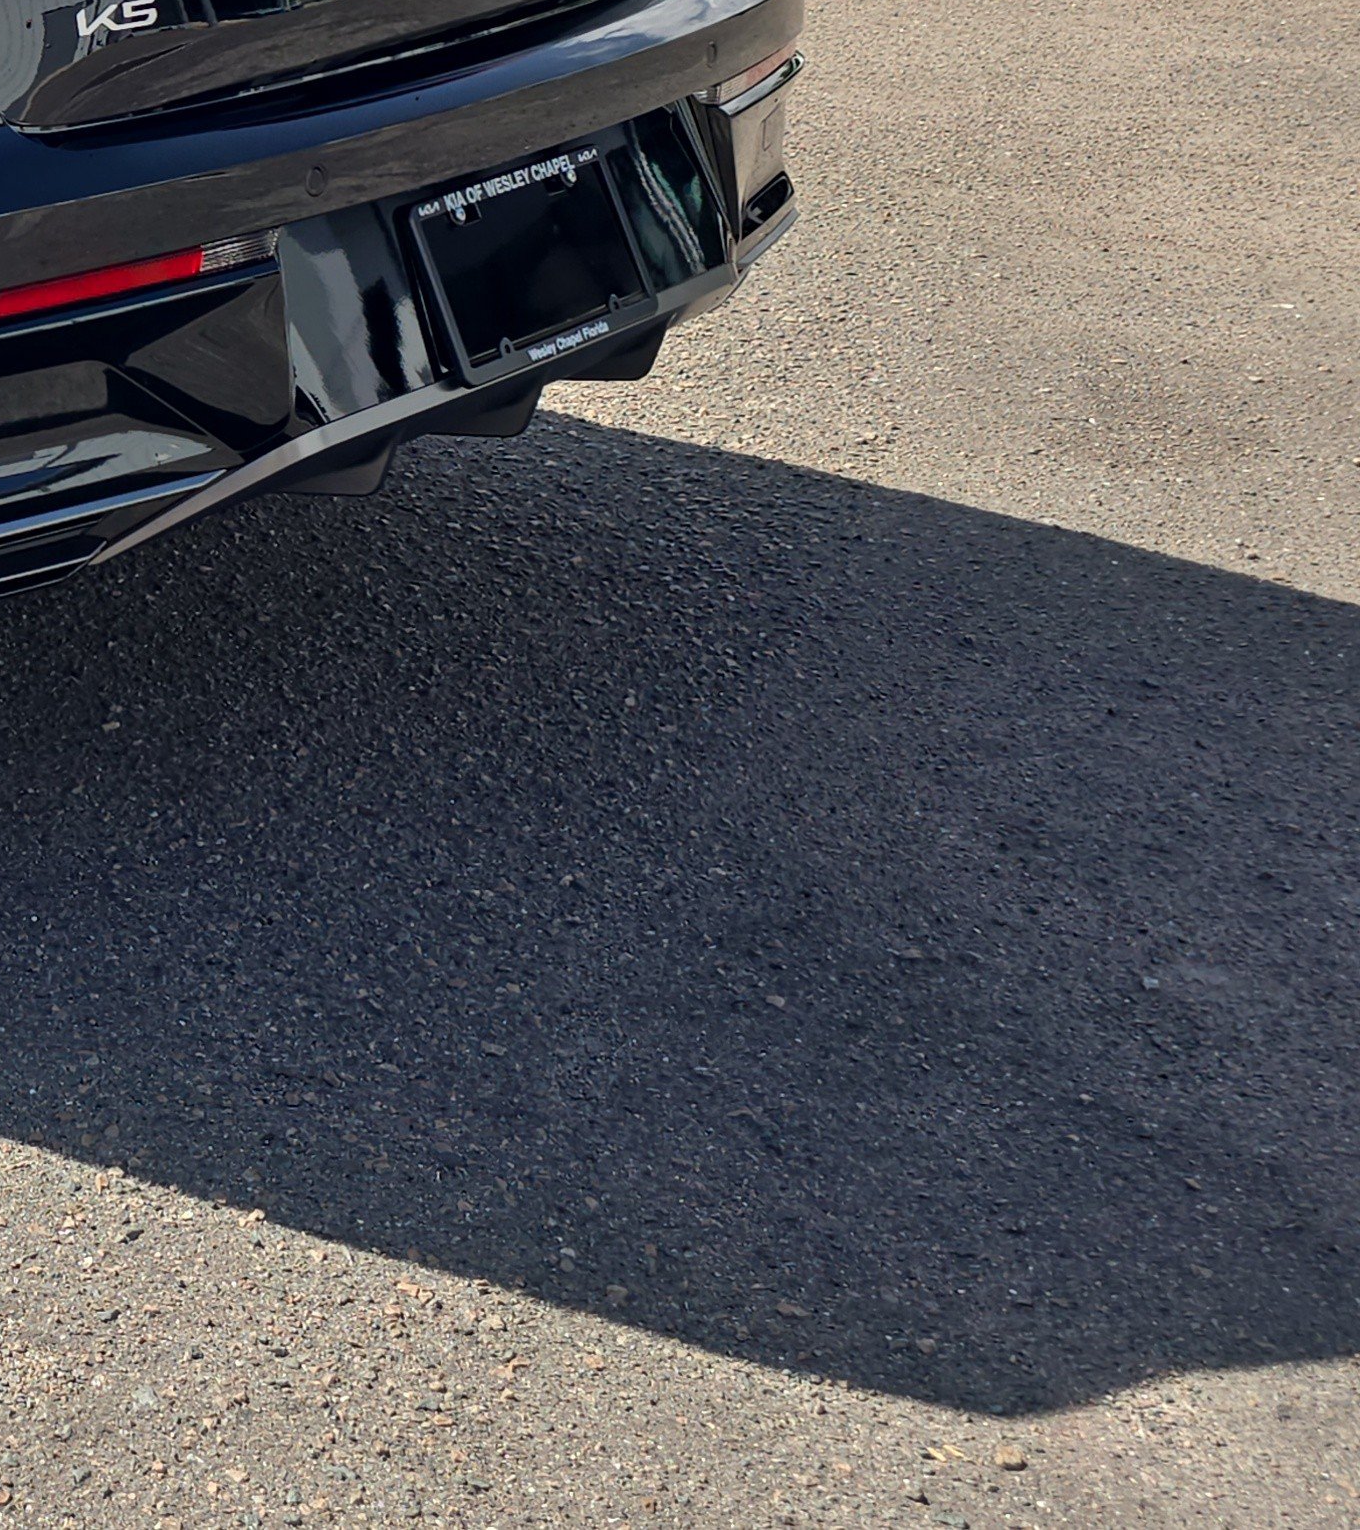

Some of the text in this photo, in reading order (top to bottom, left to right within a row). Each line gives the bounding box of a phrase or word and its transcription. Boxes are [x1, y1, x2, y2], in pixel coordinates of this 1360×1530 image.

[418, 148, 599, 216] KIA KIA OF WESLEY CHAPEL KIA
